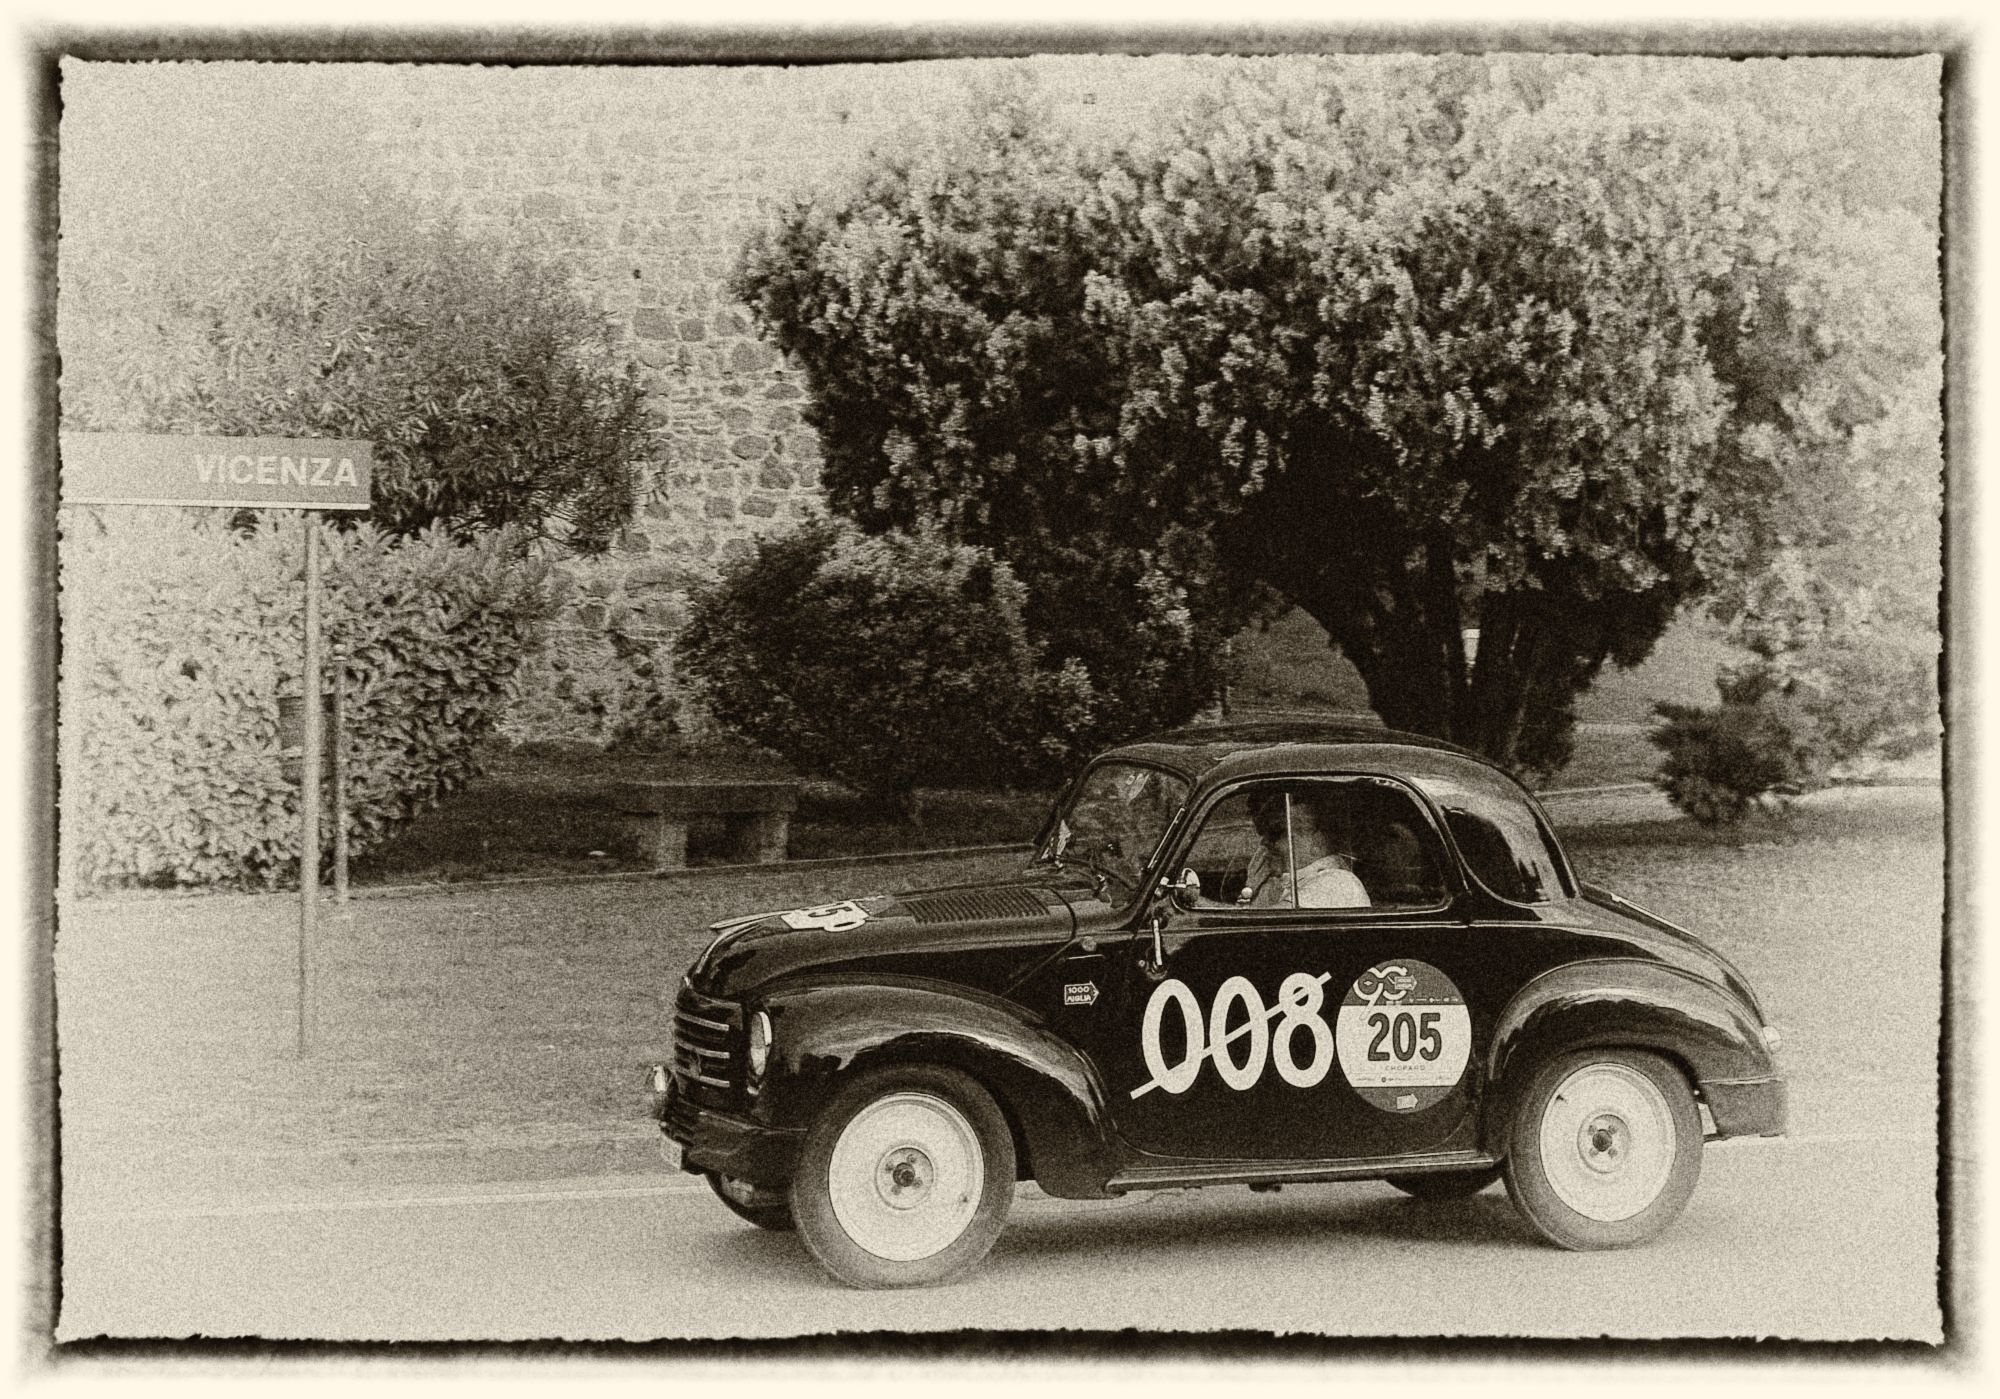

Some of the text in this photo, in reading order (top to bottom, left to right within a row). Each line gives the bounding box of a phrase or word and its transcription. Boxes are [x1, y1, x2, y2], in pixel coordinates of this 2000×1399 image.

[194, 454, 359, 488] VICENZA
[1067, 985, 1090, 994] 1000
[1367, 1011, 1443, 1062] 205
